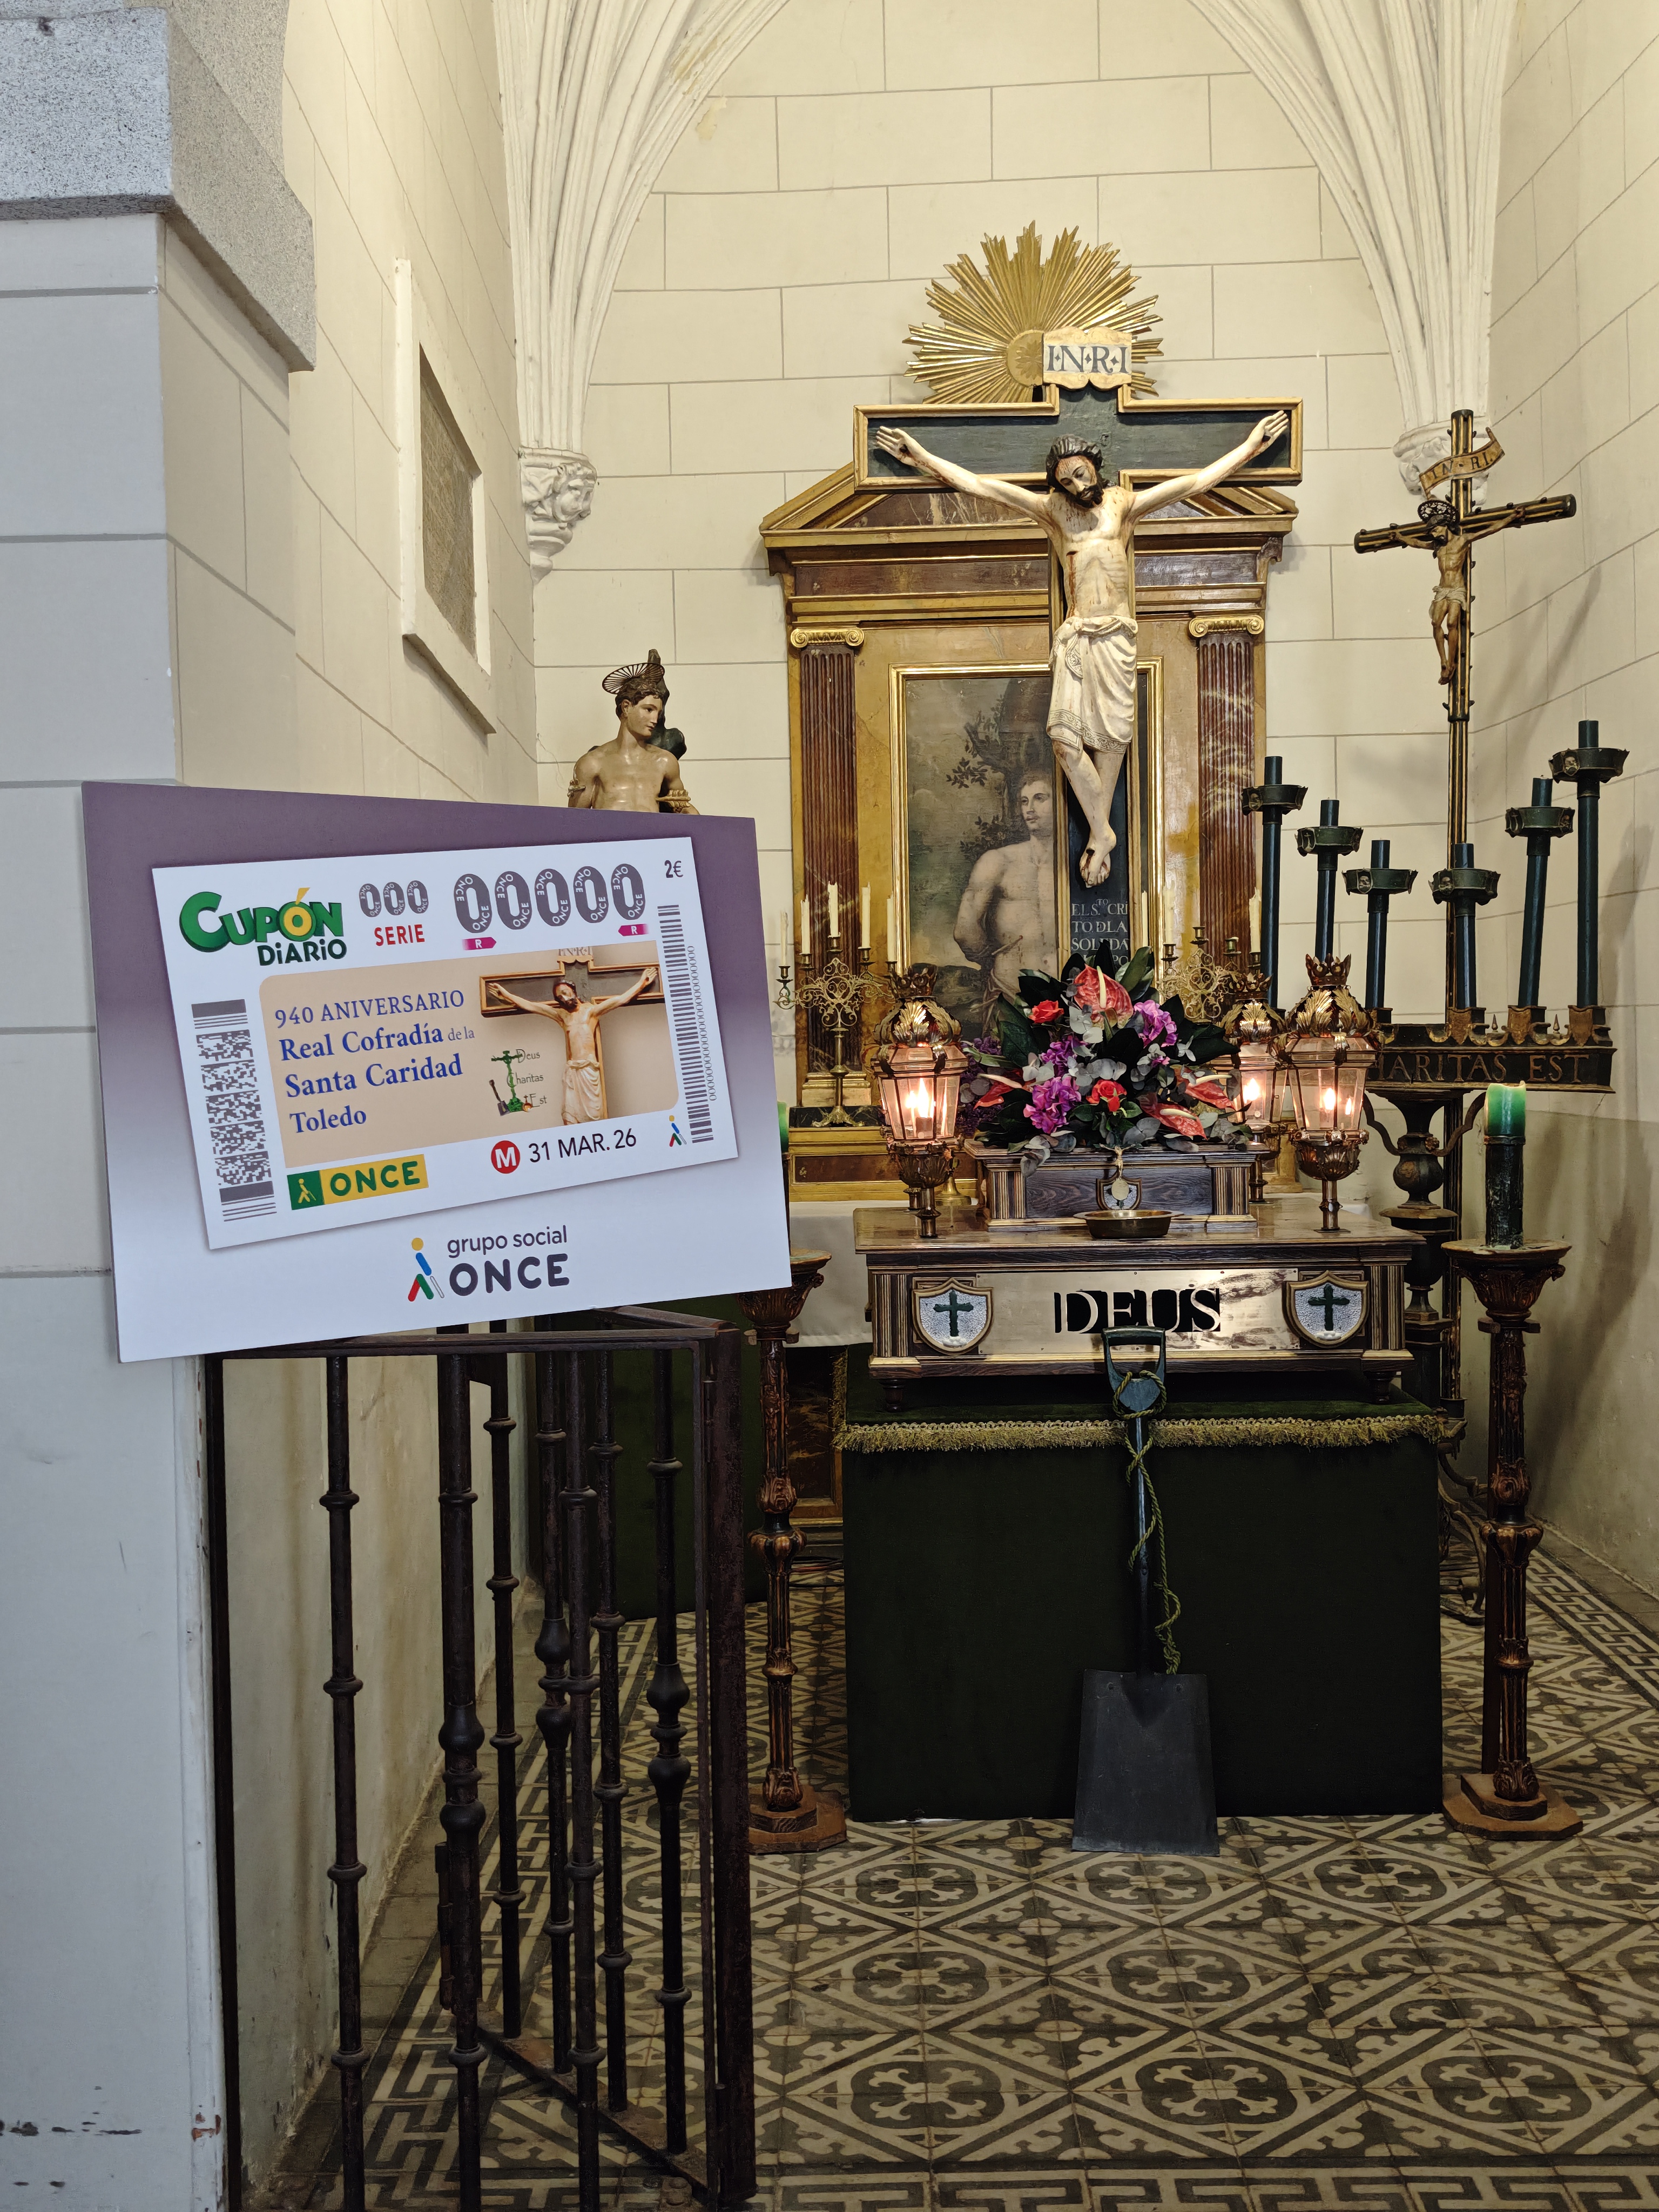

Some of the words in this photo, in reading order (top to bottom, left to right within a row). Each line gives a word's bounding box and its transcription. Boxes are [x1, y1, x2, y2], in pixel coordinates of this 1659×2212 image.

[576, 869, 591, 893] ONCE
[613, 867, 628, 890] ONCE
[664, 860, 684, 879] 2€
[456, 876, 473, 901] ONCE
[497, 874, 514, 899] ONCE
[537, 871, 552, 896] ONCE
[473, 905, 489, 930] ONCE
[513, 902, 529, 927] ONCE
[552, 900, 568, 924] ONCE
[590, 896, 606, 921] ONCE
[628, 894, 643, 918] ONCE
[374, 924, 426, 947] SERIE
[631, 925, 638, 935] R
[475, 939, 482, 949] R
[275, 1006, 314, 1029] 940
[320, 990, 464, 1022] ANIVERSARIO
[279, 1033, 335, 1061] Real
[342, 1023, 444, 1053] Cofradía
[448, 1028, 462, 1041] de
[464, 1026, 475, 1040] la
[516, 1049, 541, 1063] Deus
[285, 1071, 358, 1098] Santa
[366, 1053, 463, 1087] Caridad
[507, 1072, 544, 1088] Charitas
[1529, 1054, 1590, 1084] EST
[529, 1093, 547, 1108] Est
[289, 1105, 367, 1134] Toledo
[495, 1147, 516, 1168] M
[528, 1142, 550, 1163] 31
[558, 1132, 610, 1158] MAR.
[613, 1128, 636, 1149] 26
[330, 1161, 420, 1197] ONCE
[447, 1235, 508, 1258] grupo
[513, 1225, 567, 1247] social
[449, 1253, 570, 1297] ONCE
[1056, 1289, 1220, 1333] DEUS
